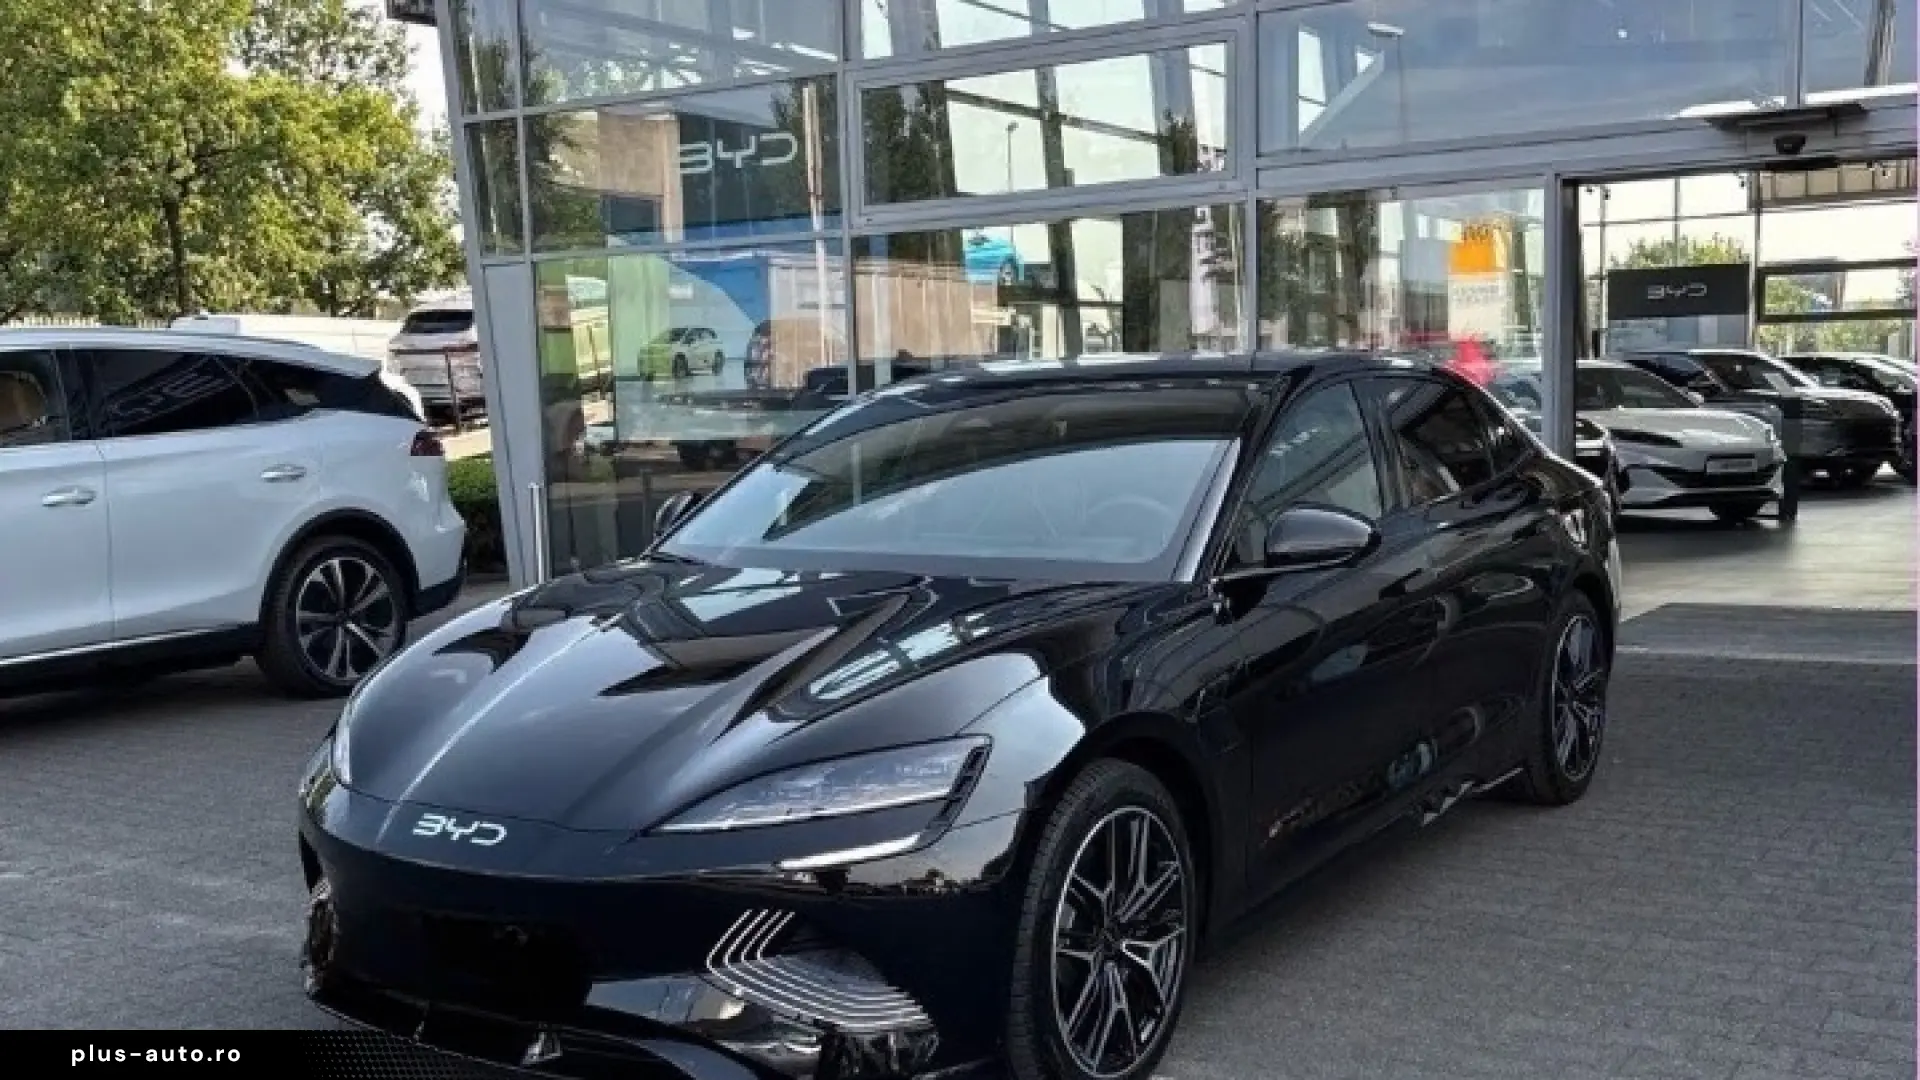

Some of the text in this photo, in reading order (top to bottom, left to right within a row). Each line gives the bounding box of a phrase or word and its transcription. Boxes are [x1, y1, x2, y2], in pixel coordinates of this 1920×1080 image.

[676, 131, 799, 174] BYD
[1646, 281, 1708, 300] BYD
[412, 812, 508, 846] BYD
